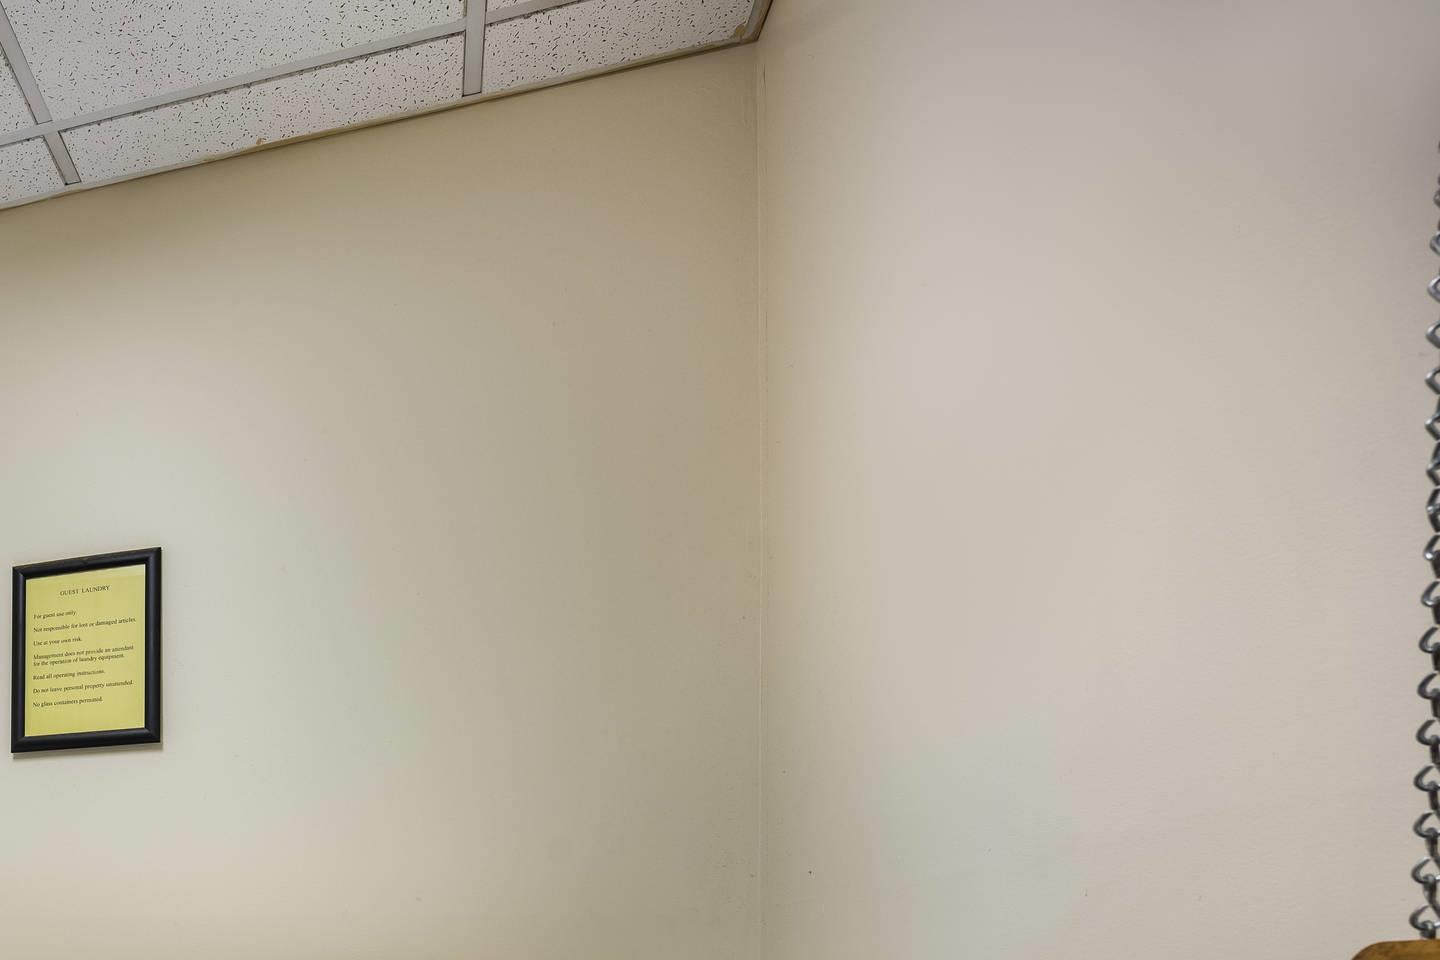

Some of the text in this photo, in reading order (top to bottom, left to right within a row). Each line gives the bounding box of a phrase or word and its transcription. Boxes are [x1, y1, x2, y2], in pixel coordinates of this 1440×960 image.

[60, 585, 110, 596] GUEST LAUNDRY
[43, 624, 70, 632] responsible
[95, 619, 117, 627] damaged
[33, 652, 63, 660] Management
[85, 647, 103, 656] provide
[112, 645, 134, 653] attendant
[49, 658, 72, 666] operation
[53, 671, 75, 679] operating
[63, 684, 83, 692] personal
[84, 682, 105, 690] property
[41, 700, 53, 708] glass
